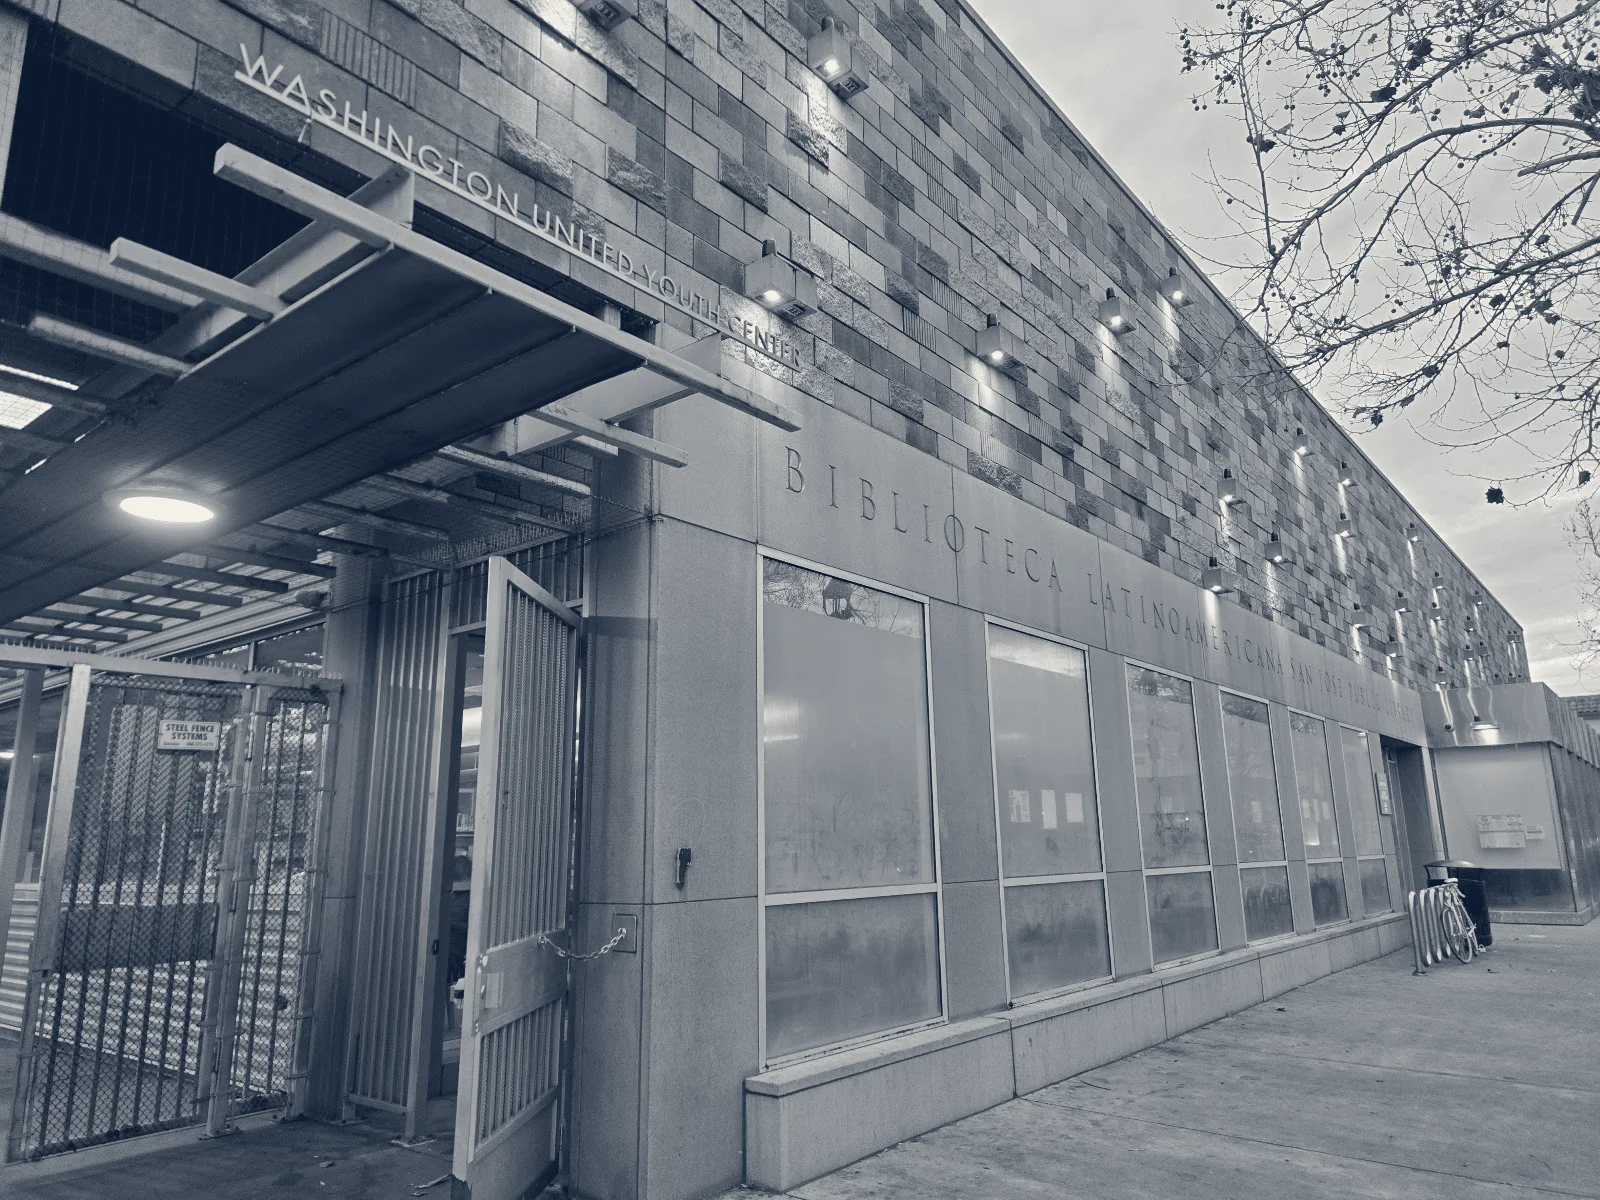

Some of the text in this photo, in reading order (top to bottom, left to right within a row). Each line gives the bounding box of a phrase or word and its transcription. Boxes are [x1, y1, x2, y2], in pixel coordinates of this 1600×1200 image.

[239, 43, 801, 368] WASHINGTON UNITED YOUTH CENTER
[784, 445, 1064, 593] BIBLIOTECA
[1087, 572, 1285, 676] LATINOAMERICANA
[1289, 657, 1313, 686] SAN
[191, 725, 214, 733] FENCE
